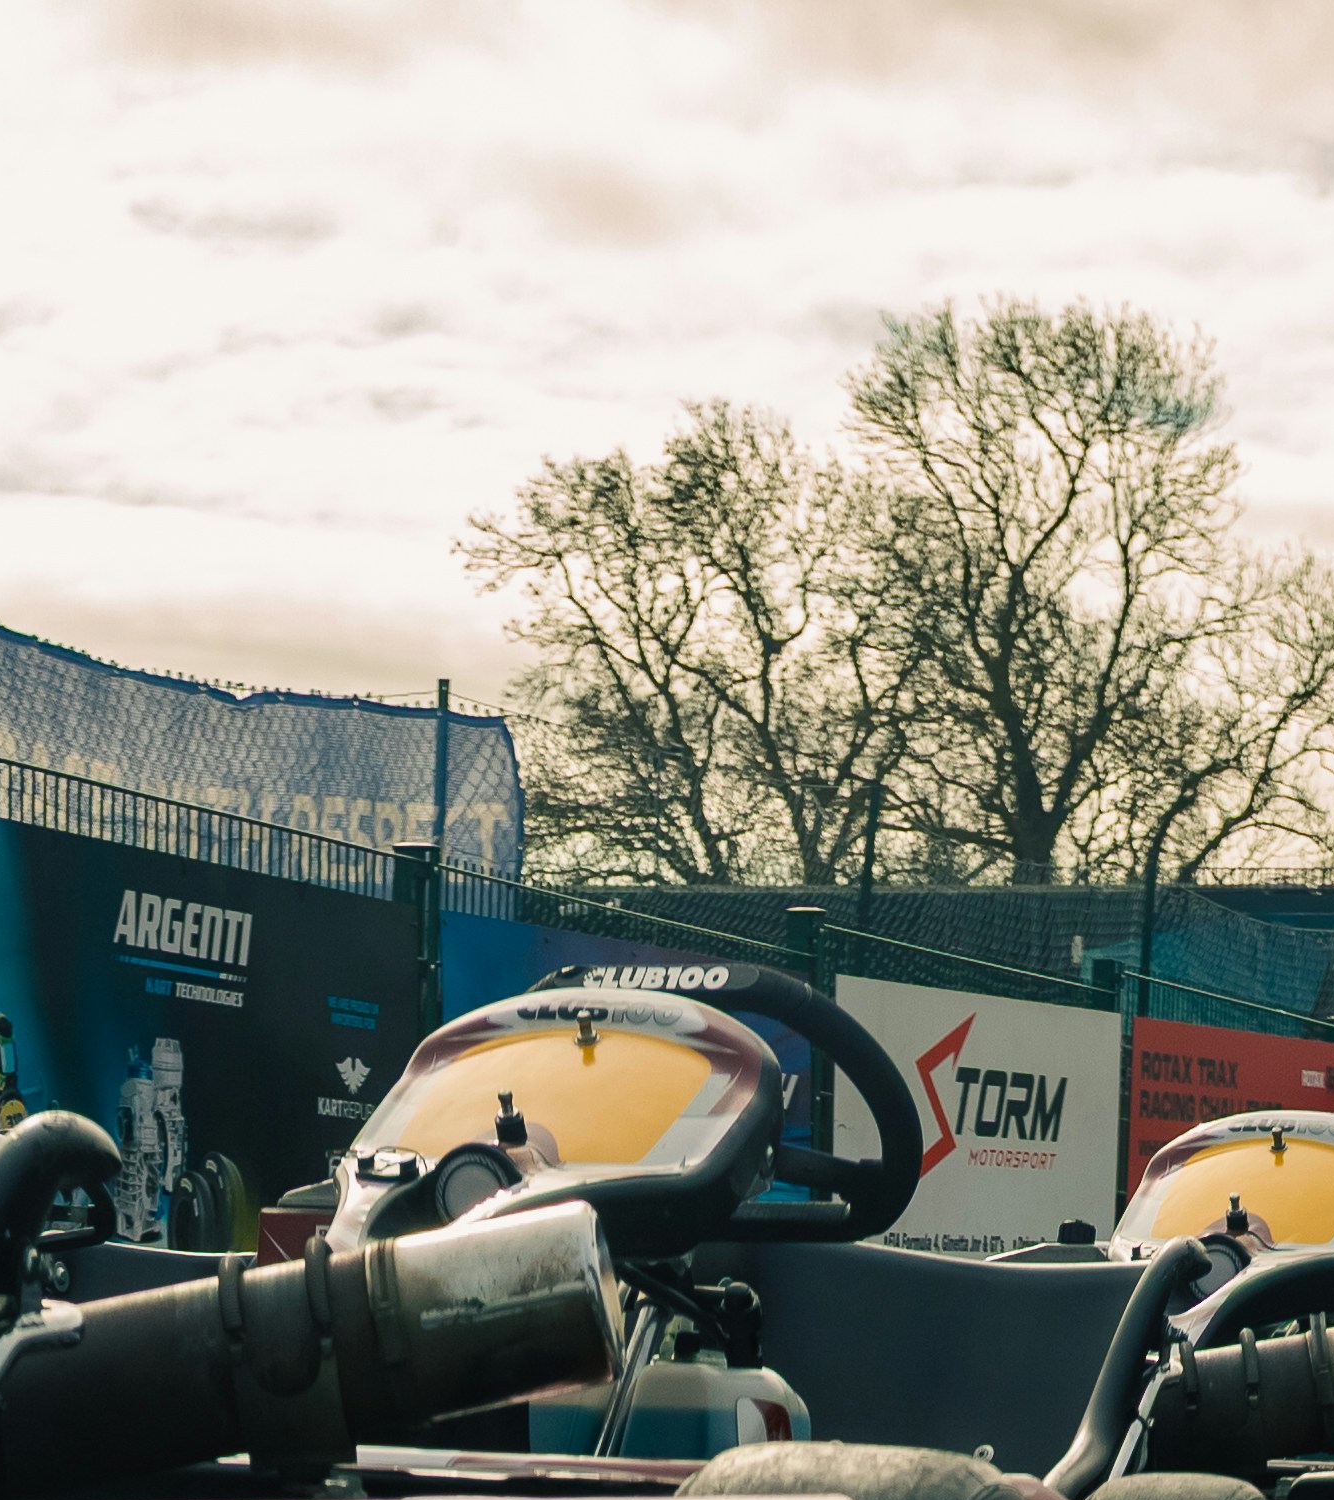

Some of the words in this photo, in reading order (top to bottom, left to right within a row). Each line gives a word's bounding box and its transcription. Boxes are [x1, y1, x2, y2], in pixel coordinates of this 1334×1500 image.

[113, 889, 253, 967] ARGENTI
[583, 966, 730, 990] CLUB100
[968, 1149, 1058, 1171] MOTORSPORT
